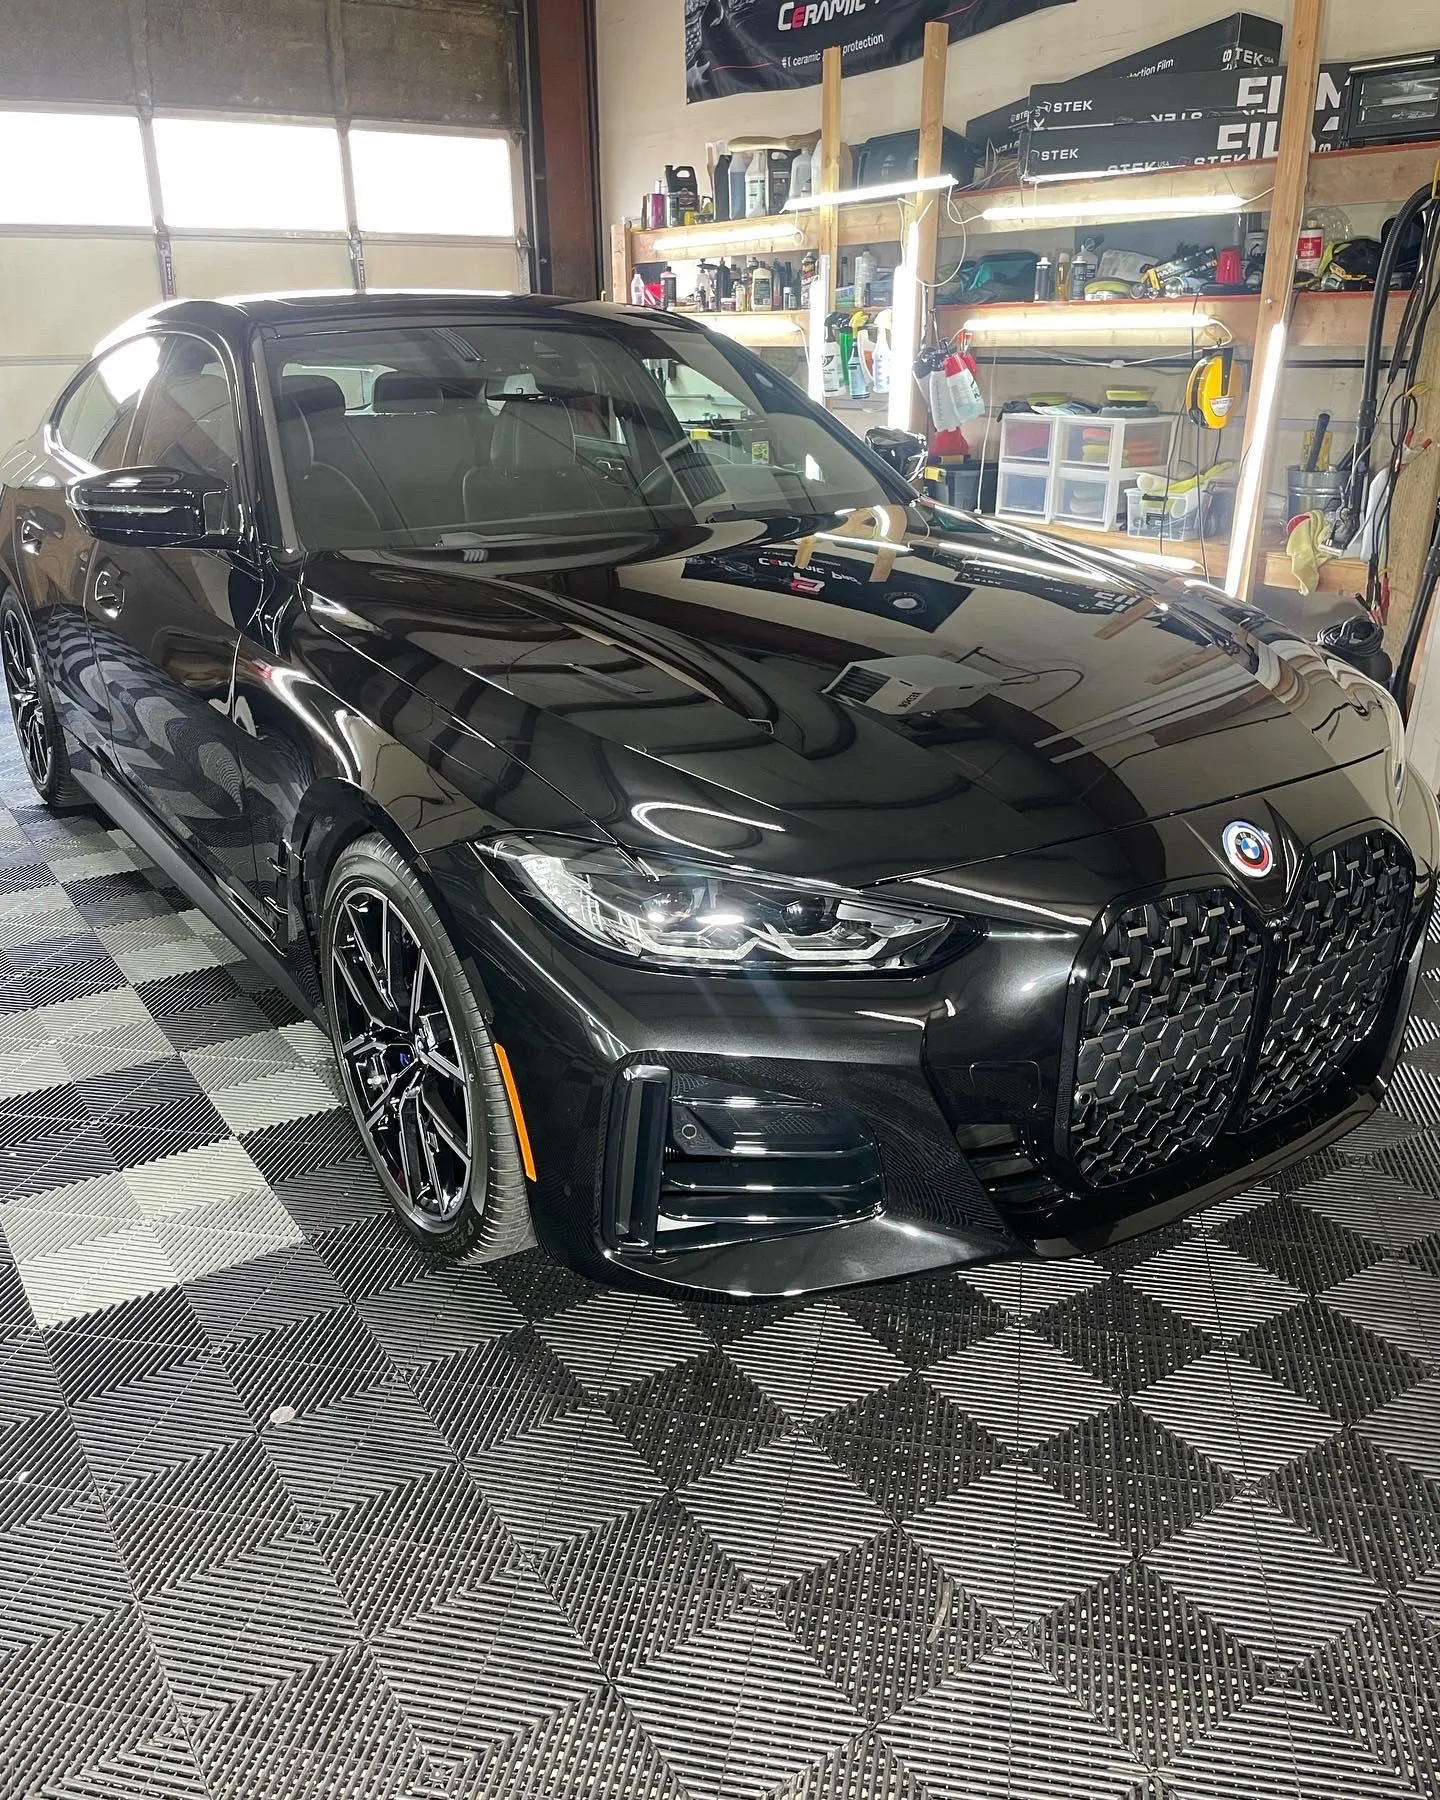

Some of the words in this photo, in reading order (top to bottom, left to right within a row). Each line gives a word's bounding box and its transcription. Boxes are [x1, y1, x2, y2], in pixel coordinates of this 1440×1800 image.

[792, 50, 821, 67] ceramic
[842, 33, 884, 57] protection
[1157, 58, 1174, 71] Film
[1237, 73, 1350, 114] FIM
[1053, 100, 1093, 113] STEK
[1041, 148, 1079, 161] STEK
